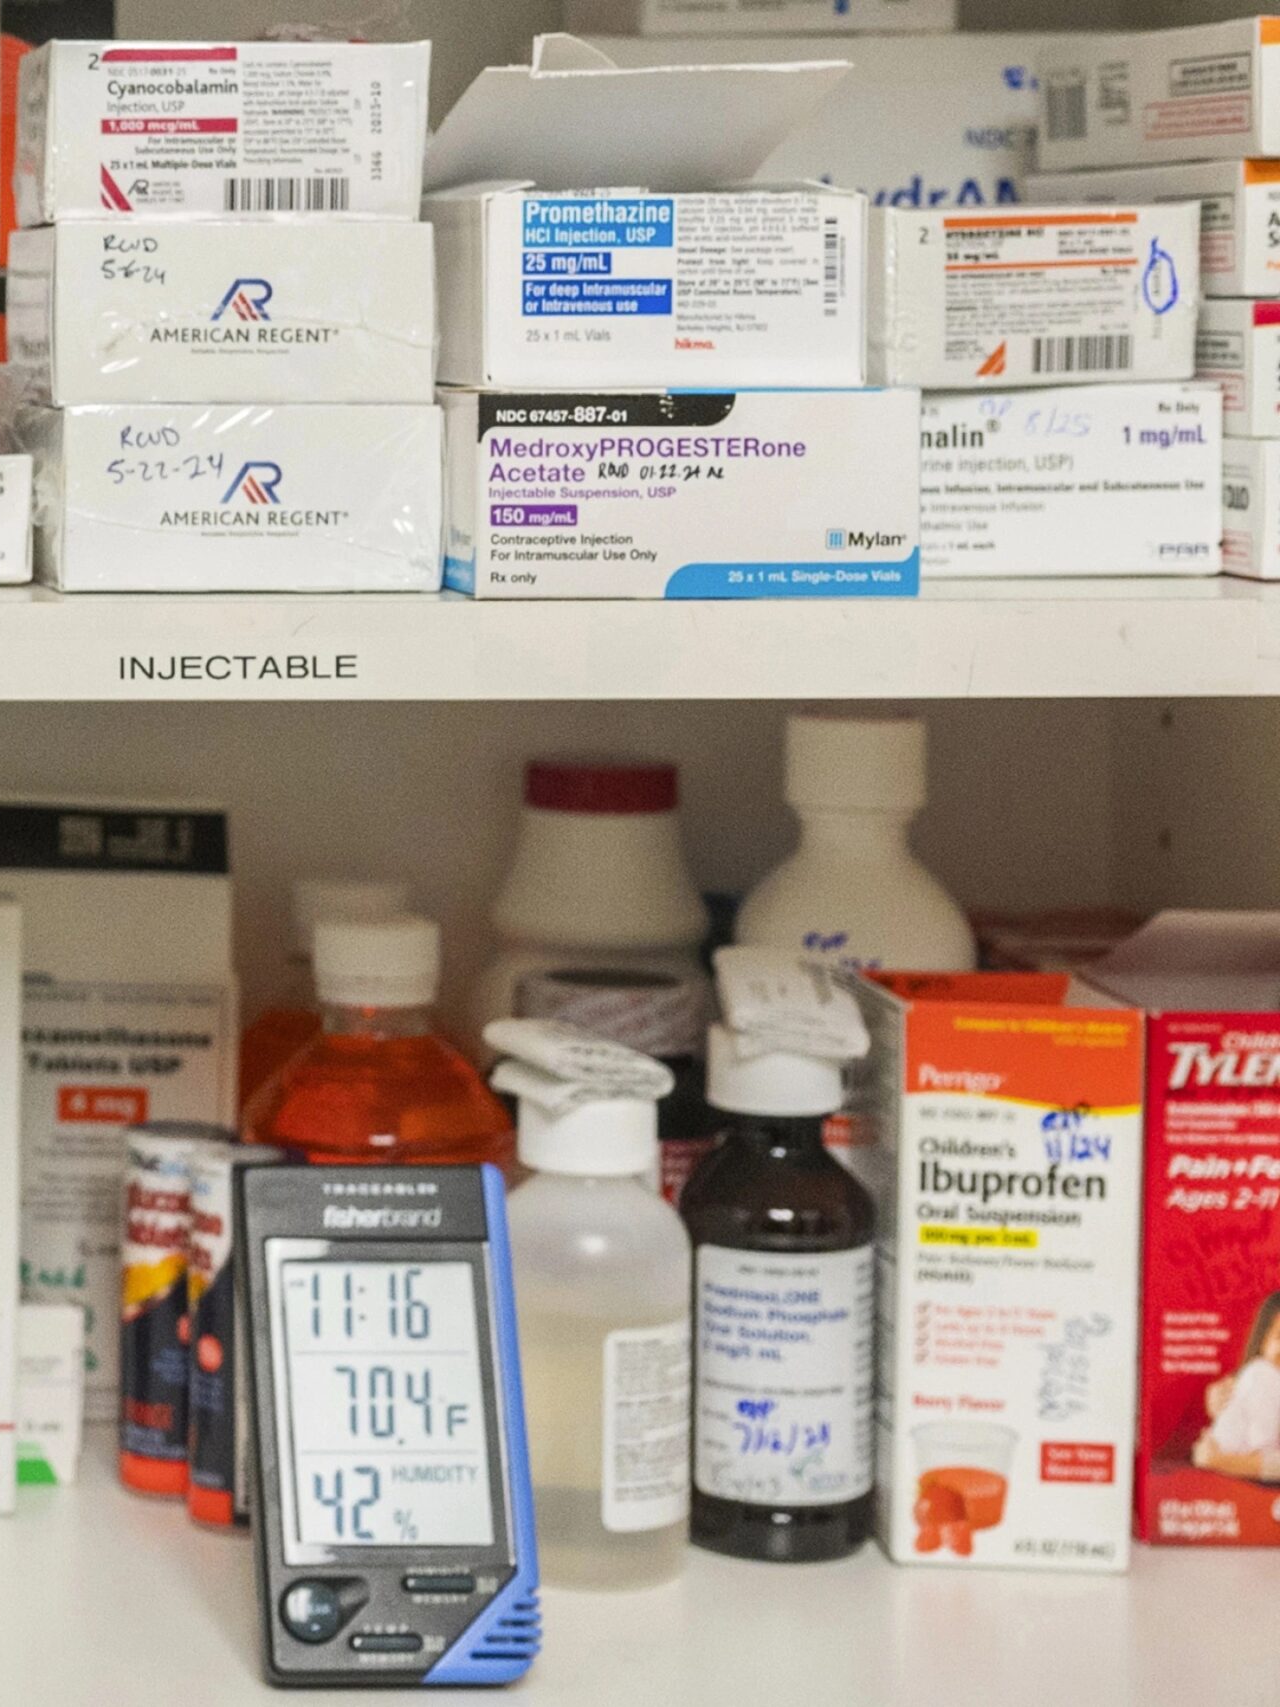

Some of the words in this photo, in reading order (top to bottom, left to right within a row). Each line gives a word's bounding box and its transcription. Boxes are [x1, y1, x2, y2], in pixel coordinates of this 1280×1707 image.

[88, 54, 99, 70] 2
[108, 81, 237, 95] Cyanocobalamin
[147, 120, 200, 134] mcg/mL
[526, 201, 671, 224] Promethazine
[626, 228, 654, 242] USP
[525, 254, 545, 270] 25
[551, 254, 606, 273] mg/mL
[525, 283, 544, 296] For
[549, 283, 579, 299] deep
[582, 283, 667, 296] Intramuscular
[525, 301, 538, 312] or
[541, 300, 612, 312] Intravenous
[616, 302, 637, 312] use
[150, 328, 251, 343] AMERICAN
[497, 410, 526, 422] NDC
[530, 406, 627, 422] 67457-887-01
[1123, 426, 1131, 443] 1
[1139, 425, 1205, 447] mg/mL
[491, 438, 805, 462] MedroxyPROGESTERone
[490, 464, 585, 481] Acetate
[490, 487, 556, 500] Injectable
[560, 487, 643, 500] Suspension,
[647, 487, 677, 497] USP
[161, 511, 259, 525] AMERICAN
[493, 508, 524, 523] 150
[529, 510, 574, 525] mg/mL
[491, 534, 577, 548] Contraceptive
[581, 534, 633, 546] Injection
[491, 550, 509, 560] For
[512, 550, 597, 560] Intramuscular
[602, 550, 624, 560] Use
[629, 550, 657, 563] Only
[491, 572, 507, 583] Rx
[511, 572, 536, 585] only
[791, 570, 869, 583] Single-Dose
[872, 570, 901, 582] Vials
[120, 655, 357, 680] INJECTABLE
[919, 1162, 1105, 1202] Ibuprofen
[323, 1206, 440, 1228] fisherbrand
[310, 1271, 430, 1339] 11:16
[446, 1405, 468, 1436] F
[314, 1467, 378, 1539] 42
[390, 1465, 478, 1484] HUMIDITY
